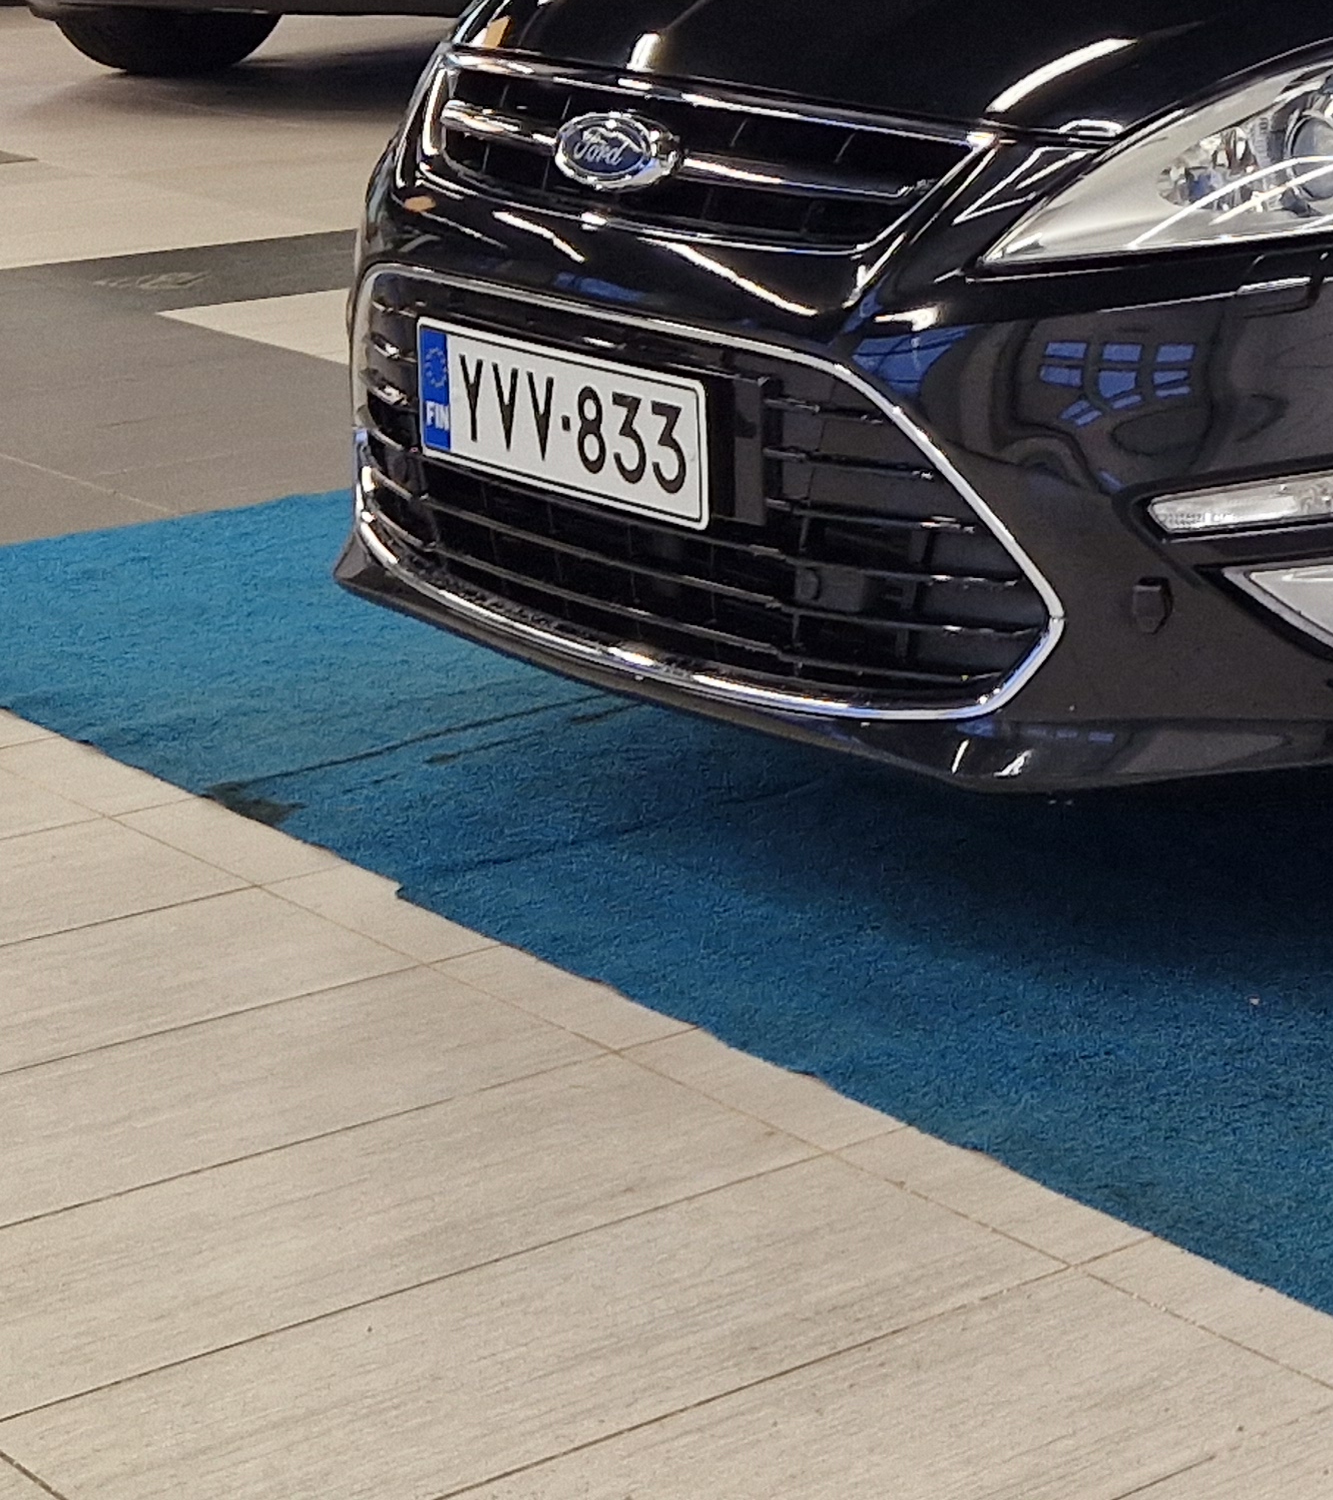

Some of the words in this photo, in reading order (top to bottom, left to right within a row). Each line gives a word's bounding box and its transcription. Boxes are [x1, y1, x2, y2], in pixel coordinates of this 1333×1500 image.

[573, 127, 630, 166] Ford
[426, 402, 449, 431] FIN
[459, 353, 687, 494] YVV-833
